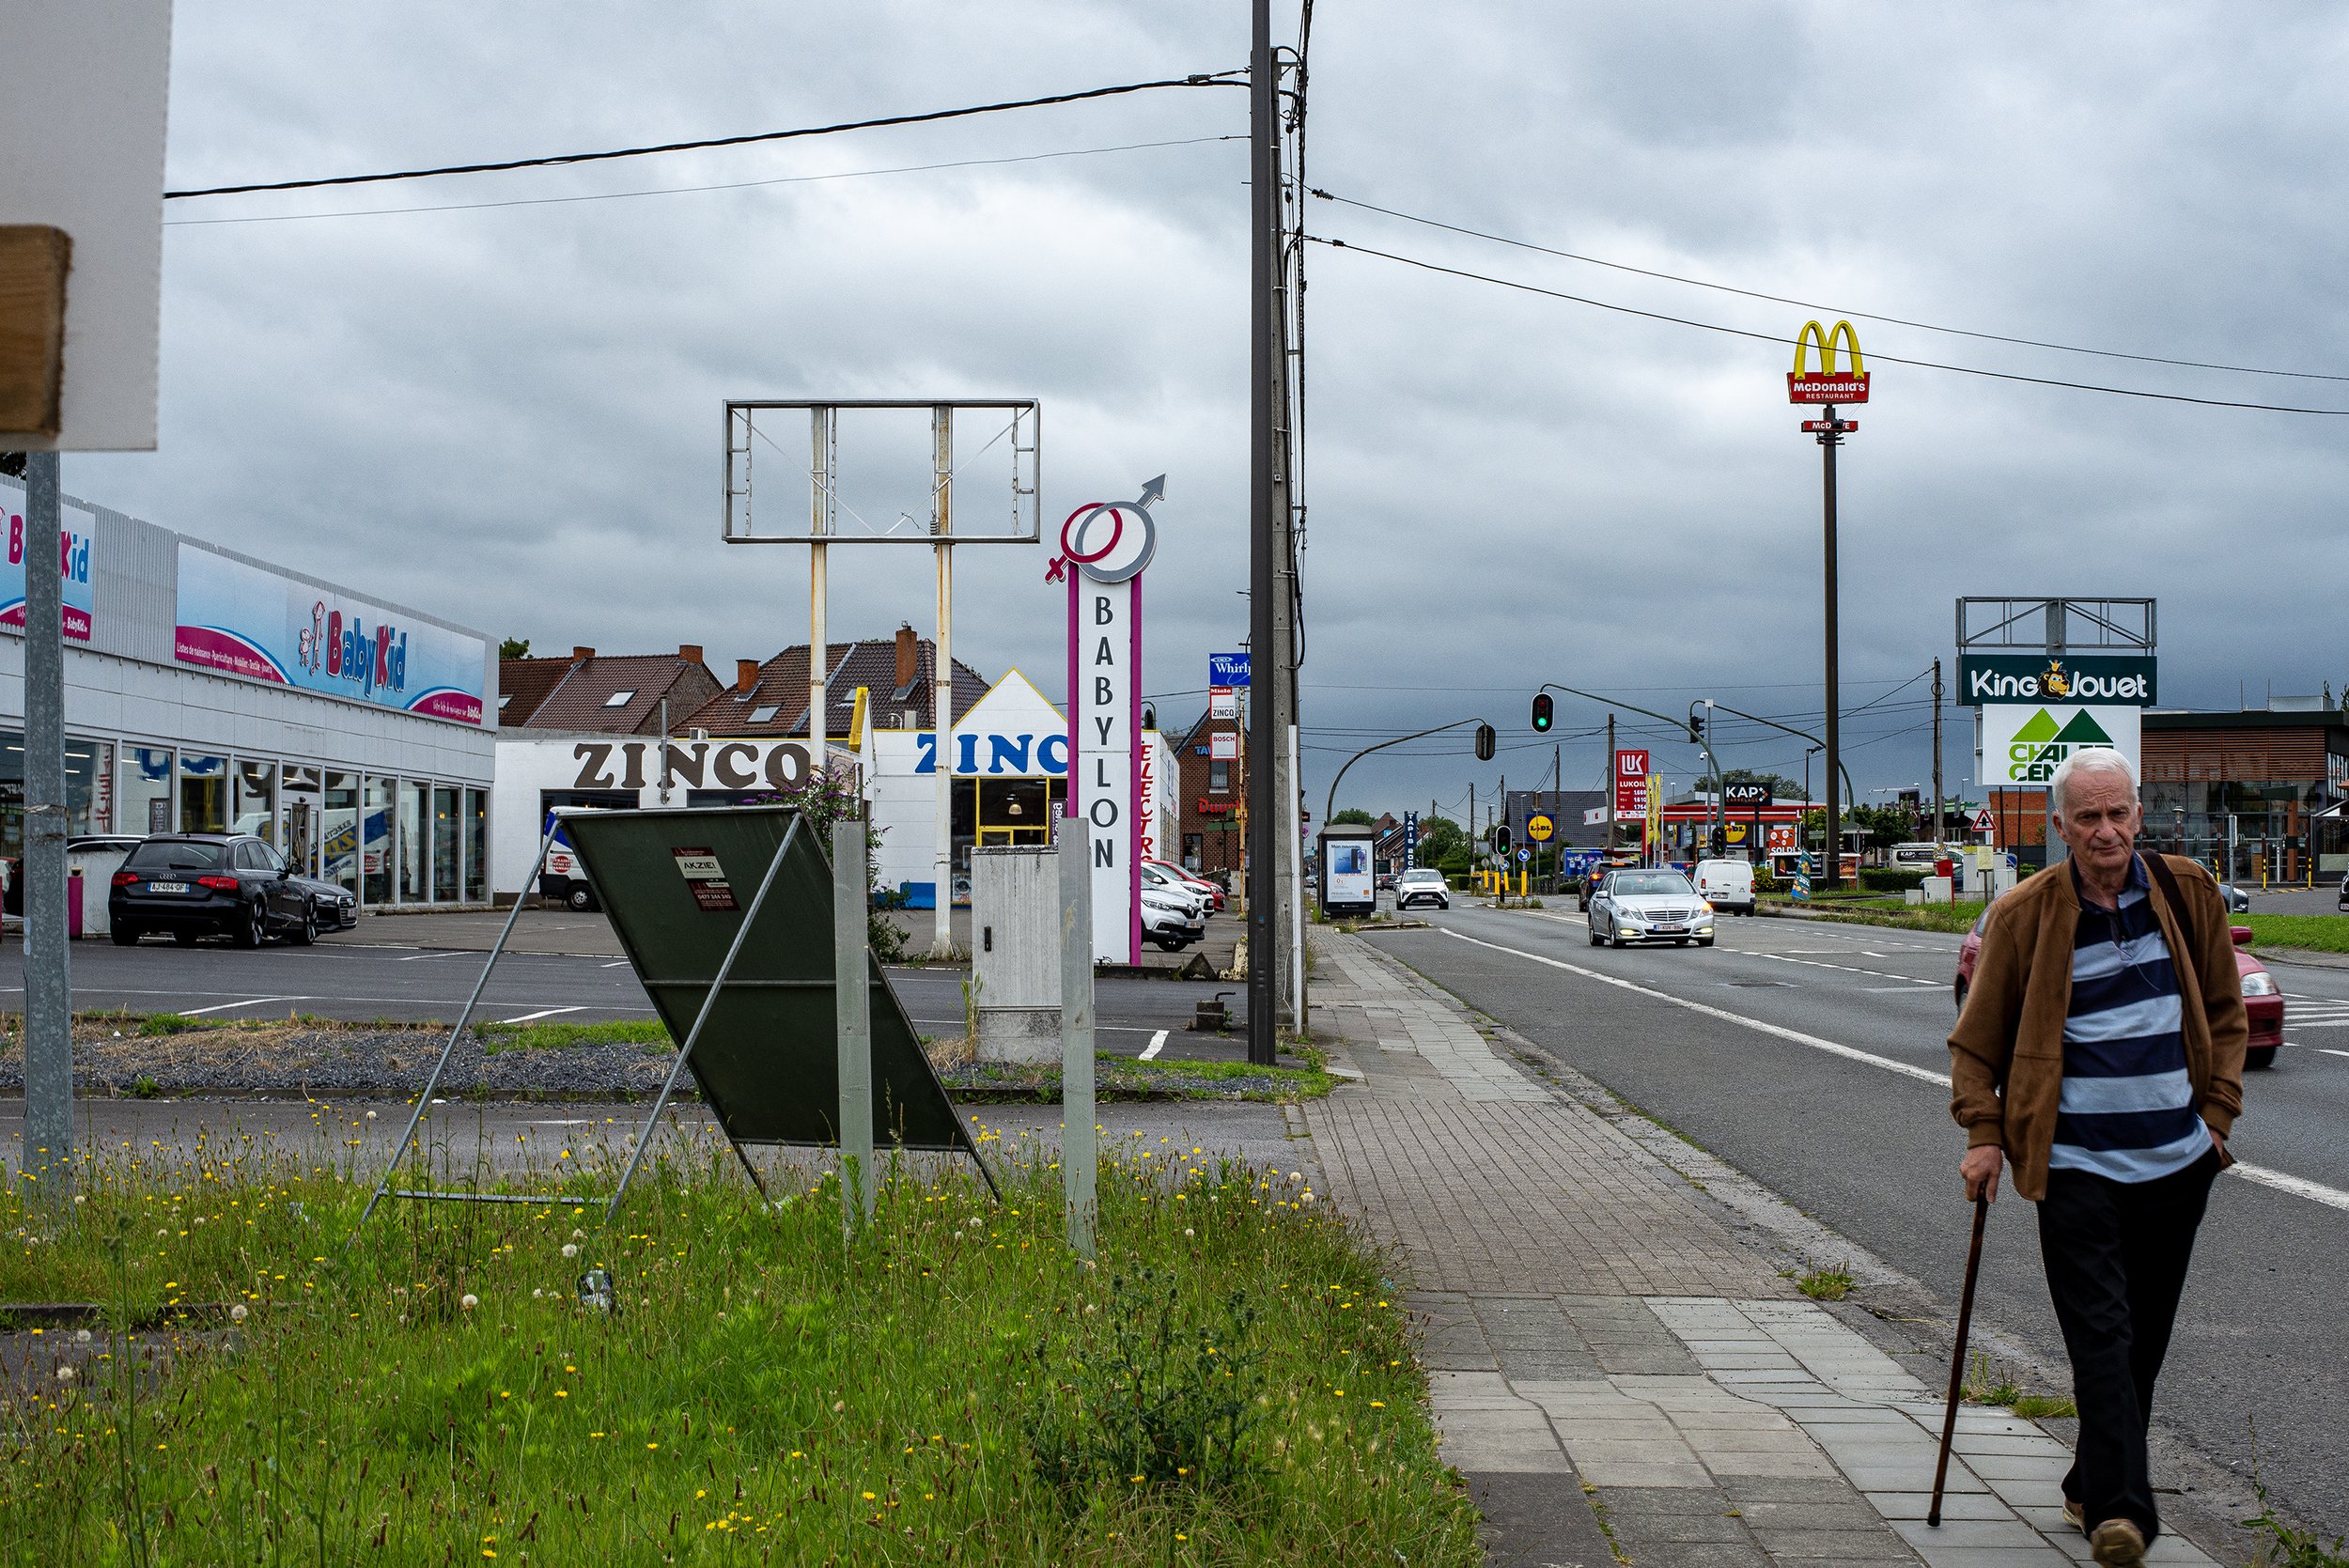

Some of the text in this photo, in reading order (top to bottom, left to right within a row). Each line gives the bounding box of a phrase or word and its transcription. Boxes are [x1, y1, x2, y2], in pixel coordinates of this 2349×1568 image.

[1793, 382, 1866, 392] McDonald's
[8, 515, 89, 583] BKid
[327, 611, 407, 697] BabyKid
[2065, 671, 2148, 698] Jouet
[1090, 596, 1118, 868] BABYLON
[1726, 786, 1759, 798] KAP
